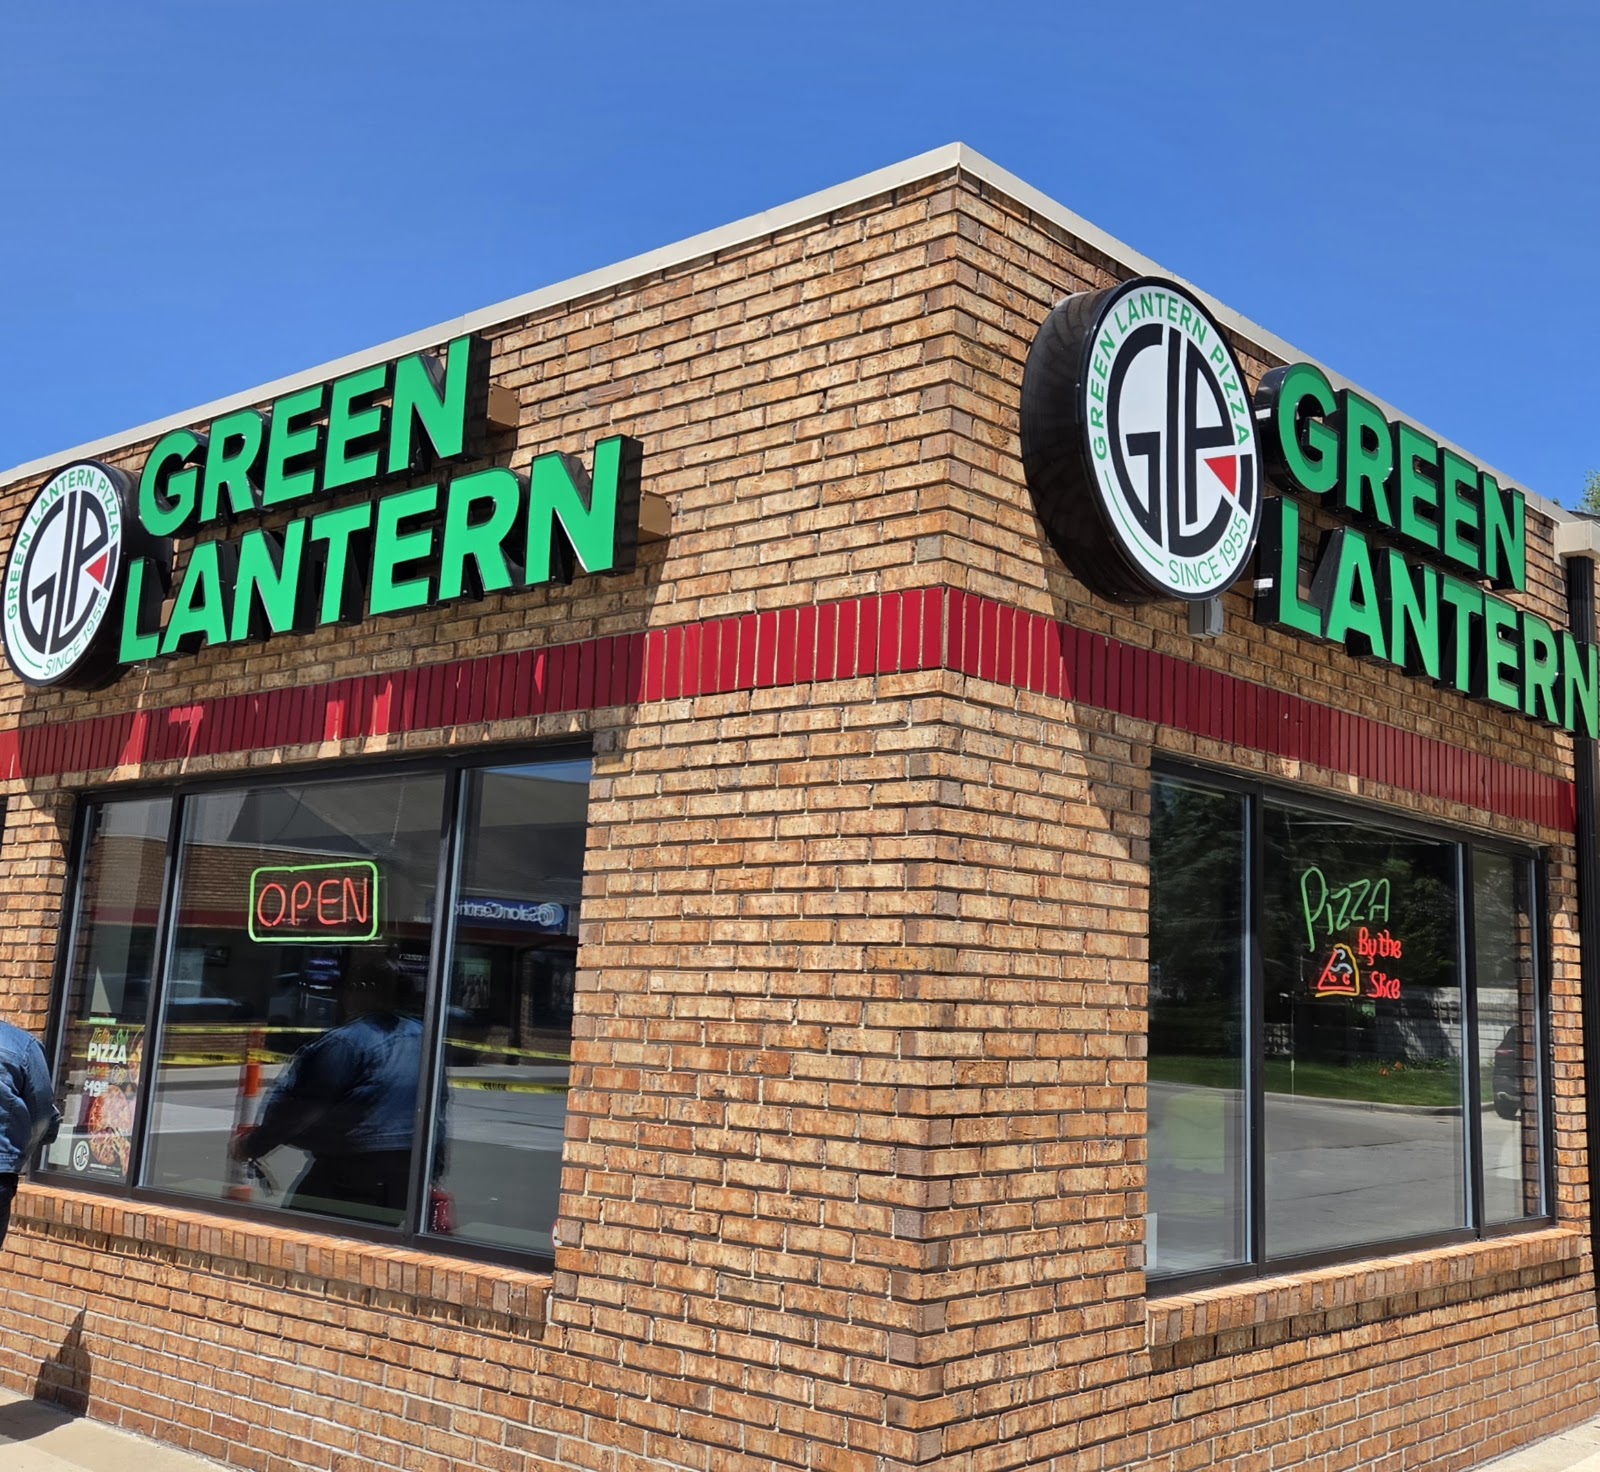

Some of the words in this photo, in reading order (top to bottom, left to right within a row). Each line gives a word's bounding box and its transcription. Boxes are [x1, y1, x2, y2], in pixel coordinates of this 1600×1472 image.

[139, 334, 472, 536] GREEN
[1091, 329, 1115, 461] GREEN
[1114, 292, 1208, 346] LANTERN
[1209, 343, 1250, 446] PIZZA
[1278, 361, 1525, 593] GREEN
[7, 532, 31, 620] GREEN
[30, 469, 95, 525] LANTERN
[96, 476, 119, 539] PIZZA
[118, 434, 622, 664] LANTERN
[1168, 554, 1223, 588] SINCE
[1218, 512, 1249, 568] 1955
[43, 643, 81, 677] SINCE
[82, 594, 107, 642] 1955
[1279, 496, 1599, 740] LANTERN
[257, 877, 368, 927] OPEN
[1358, 927, 1377, 966] By
[1377, 929, 1402, 958] the
[1367, 971, 1401, 999] Slice
[87, 1042, 127, 1064] PIZZA
